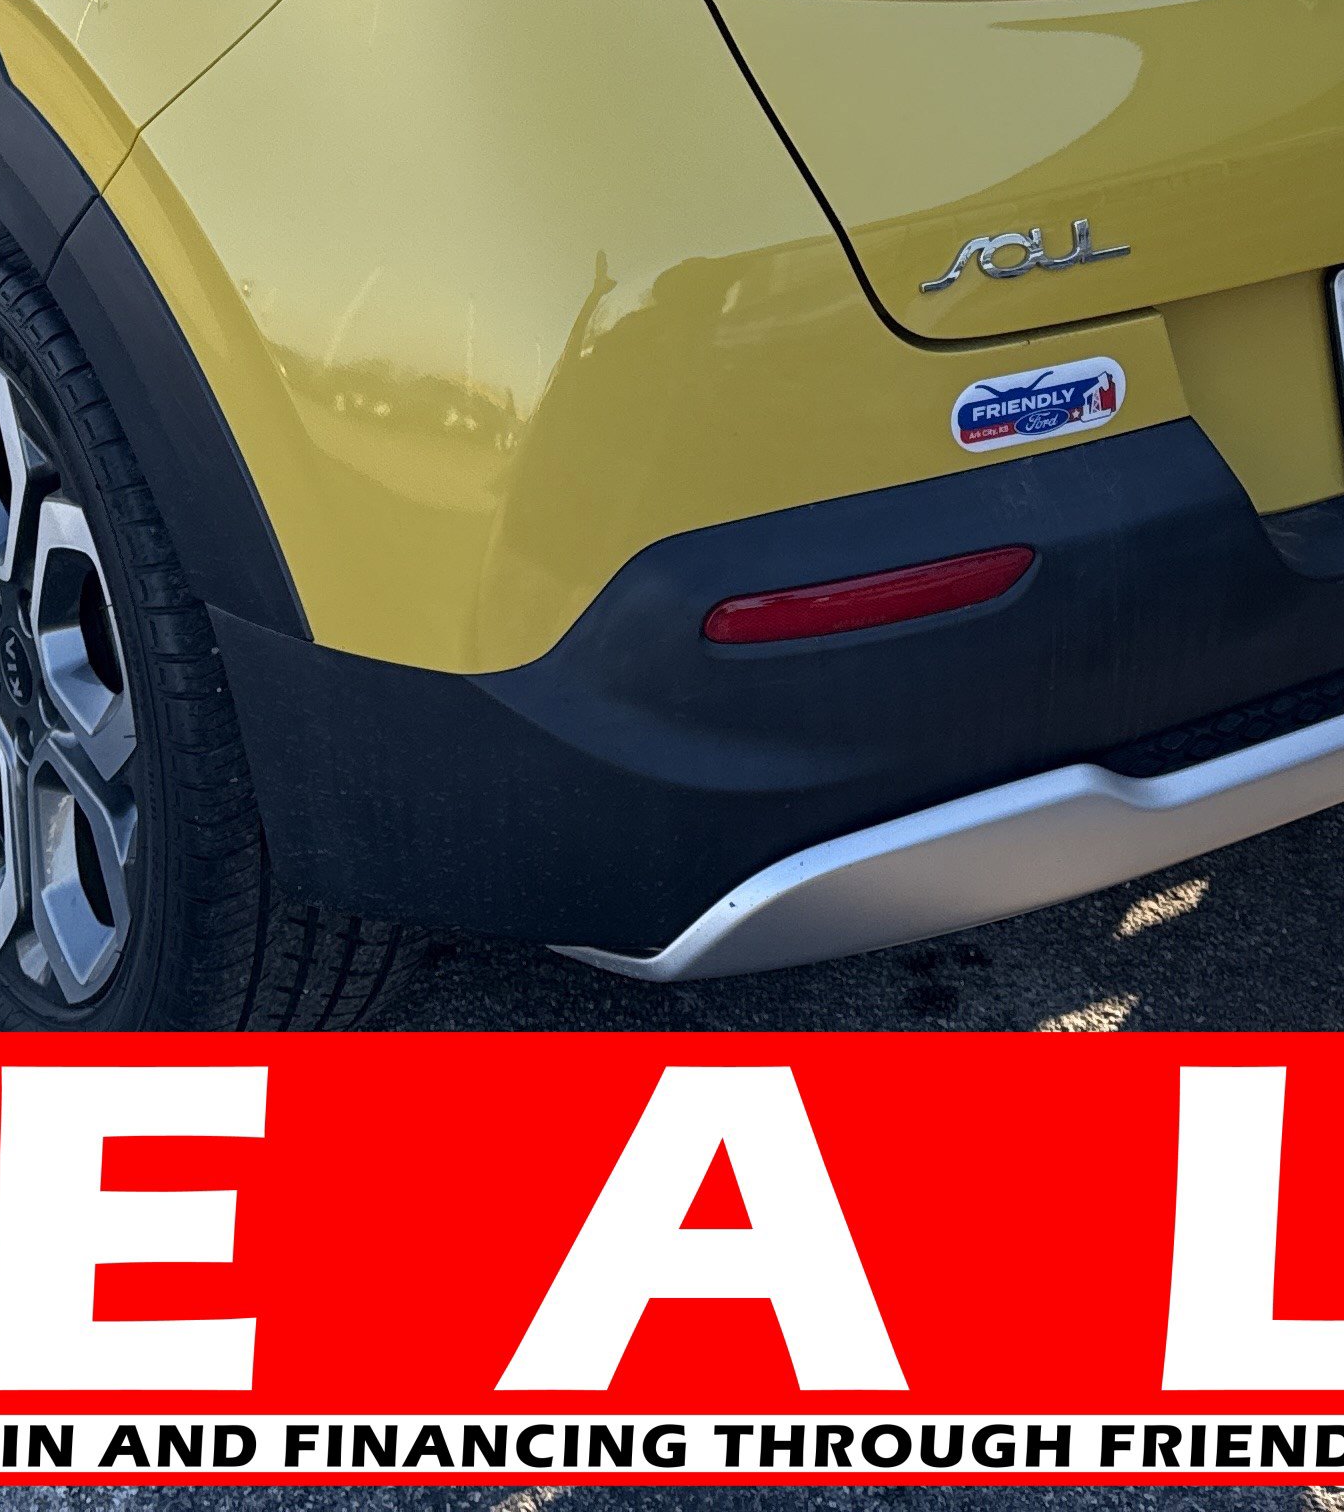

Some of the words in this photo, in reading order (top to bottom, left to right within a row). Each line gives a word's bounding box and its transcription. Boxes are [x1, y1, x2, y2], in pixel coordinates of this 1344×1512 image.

[919, 218, 1132, 294] SOUL
[972, 387, 1075, 422] FRIENDLY
[1025, 411, 1059, 432] Ford
[5, 635, 24, 698] KIA
